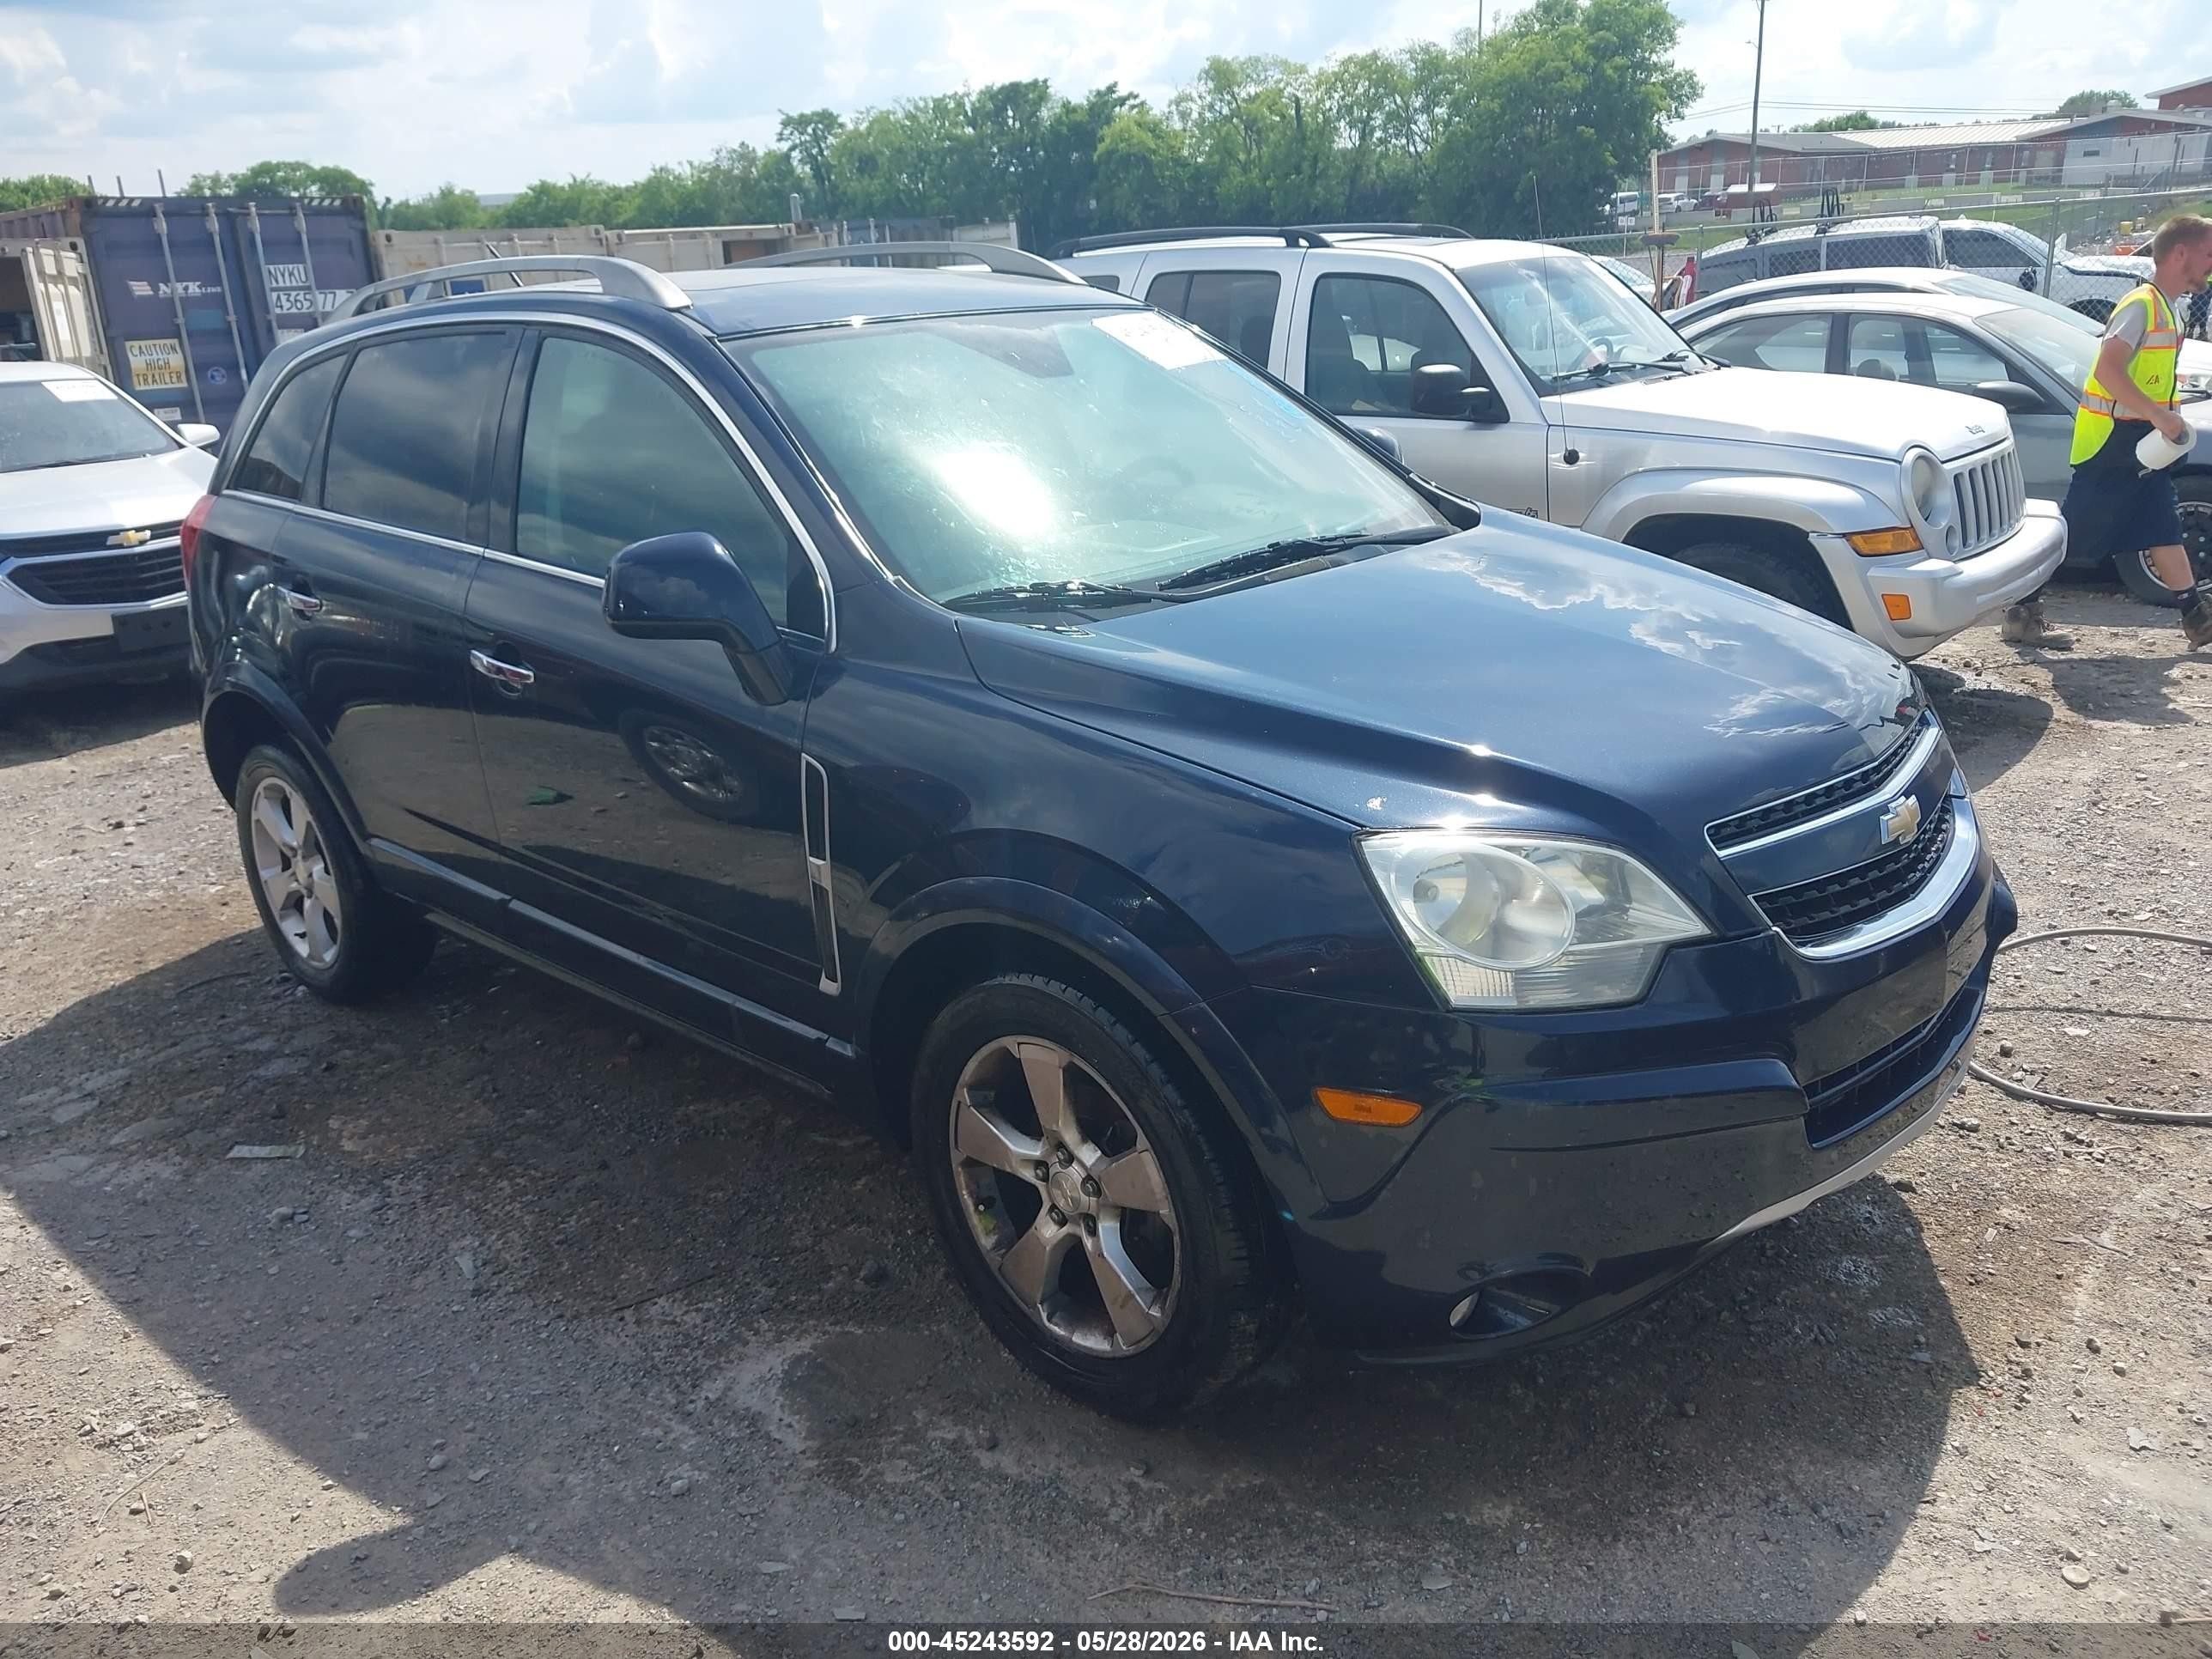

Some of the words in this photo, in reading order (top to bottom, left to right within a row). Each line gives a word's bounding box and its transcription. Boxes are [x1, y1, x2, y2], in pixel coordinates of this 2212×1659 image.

[268, 264, 309, 285] NYKU
[130, 343, 179, 357] CAUTION
[145, 357, 171, 372] HIGH
[135, 371, 184, 386] TRAILER
